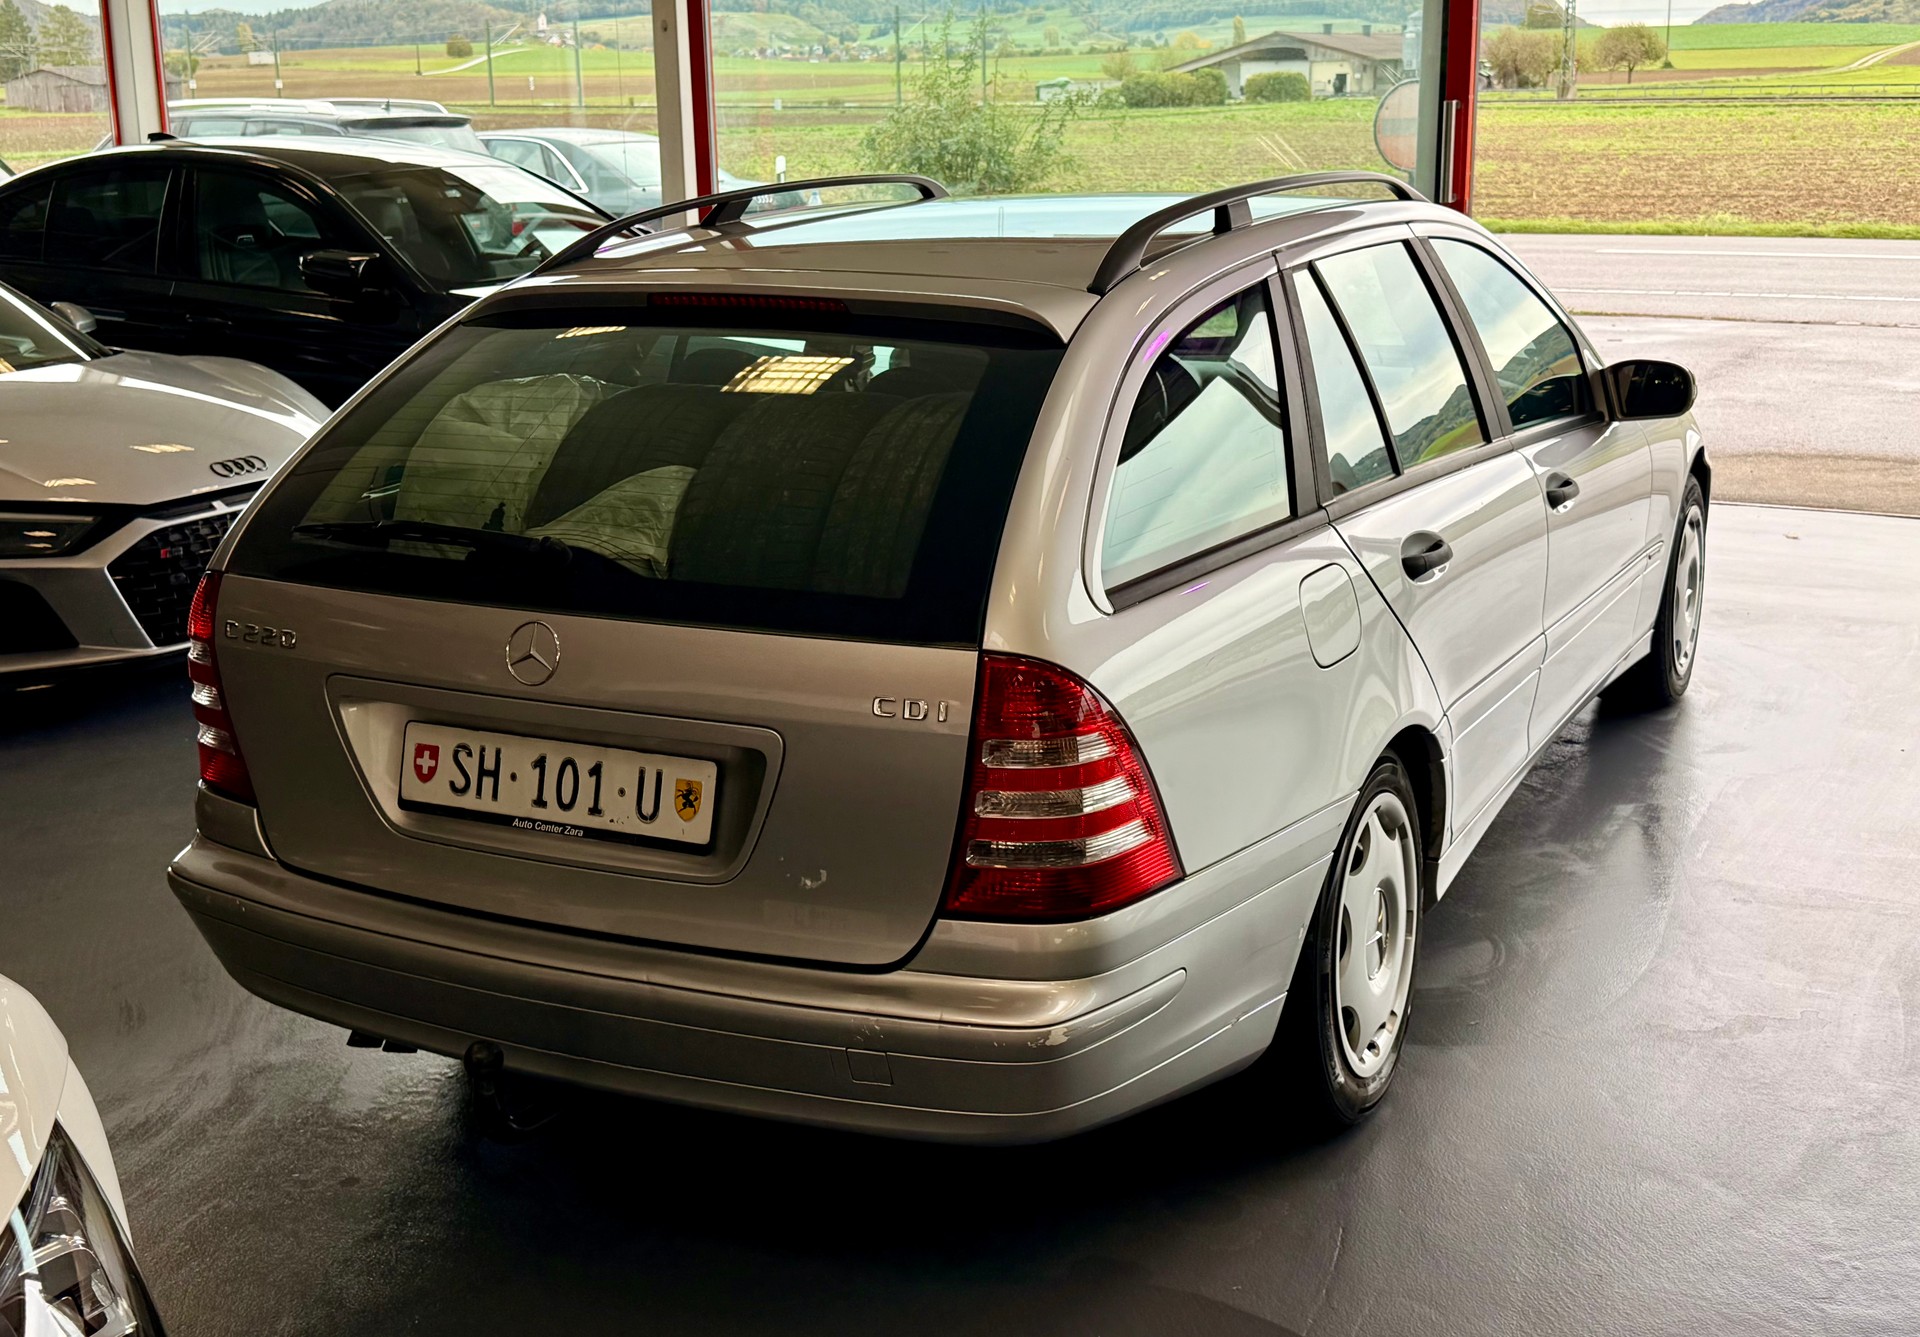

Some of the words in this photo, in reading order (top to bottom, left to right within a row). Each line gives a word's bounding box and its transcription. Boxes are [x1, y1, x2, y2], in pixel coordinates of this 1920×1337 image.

[225, 619, 239, 639] C
[243, 623, 297, 649] 220
[872, 696, 948, 723] CDI
[512, 818, 533, 829] Auto
[534, 821, 564, 834] Center
[563, 825, 584, 837] Zara
